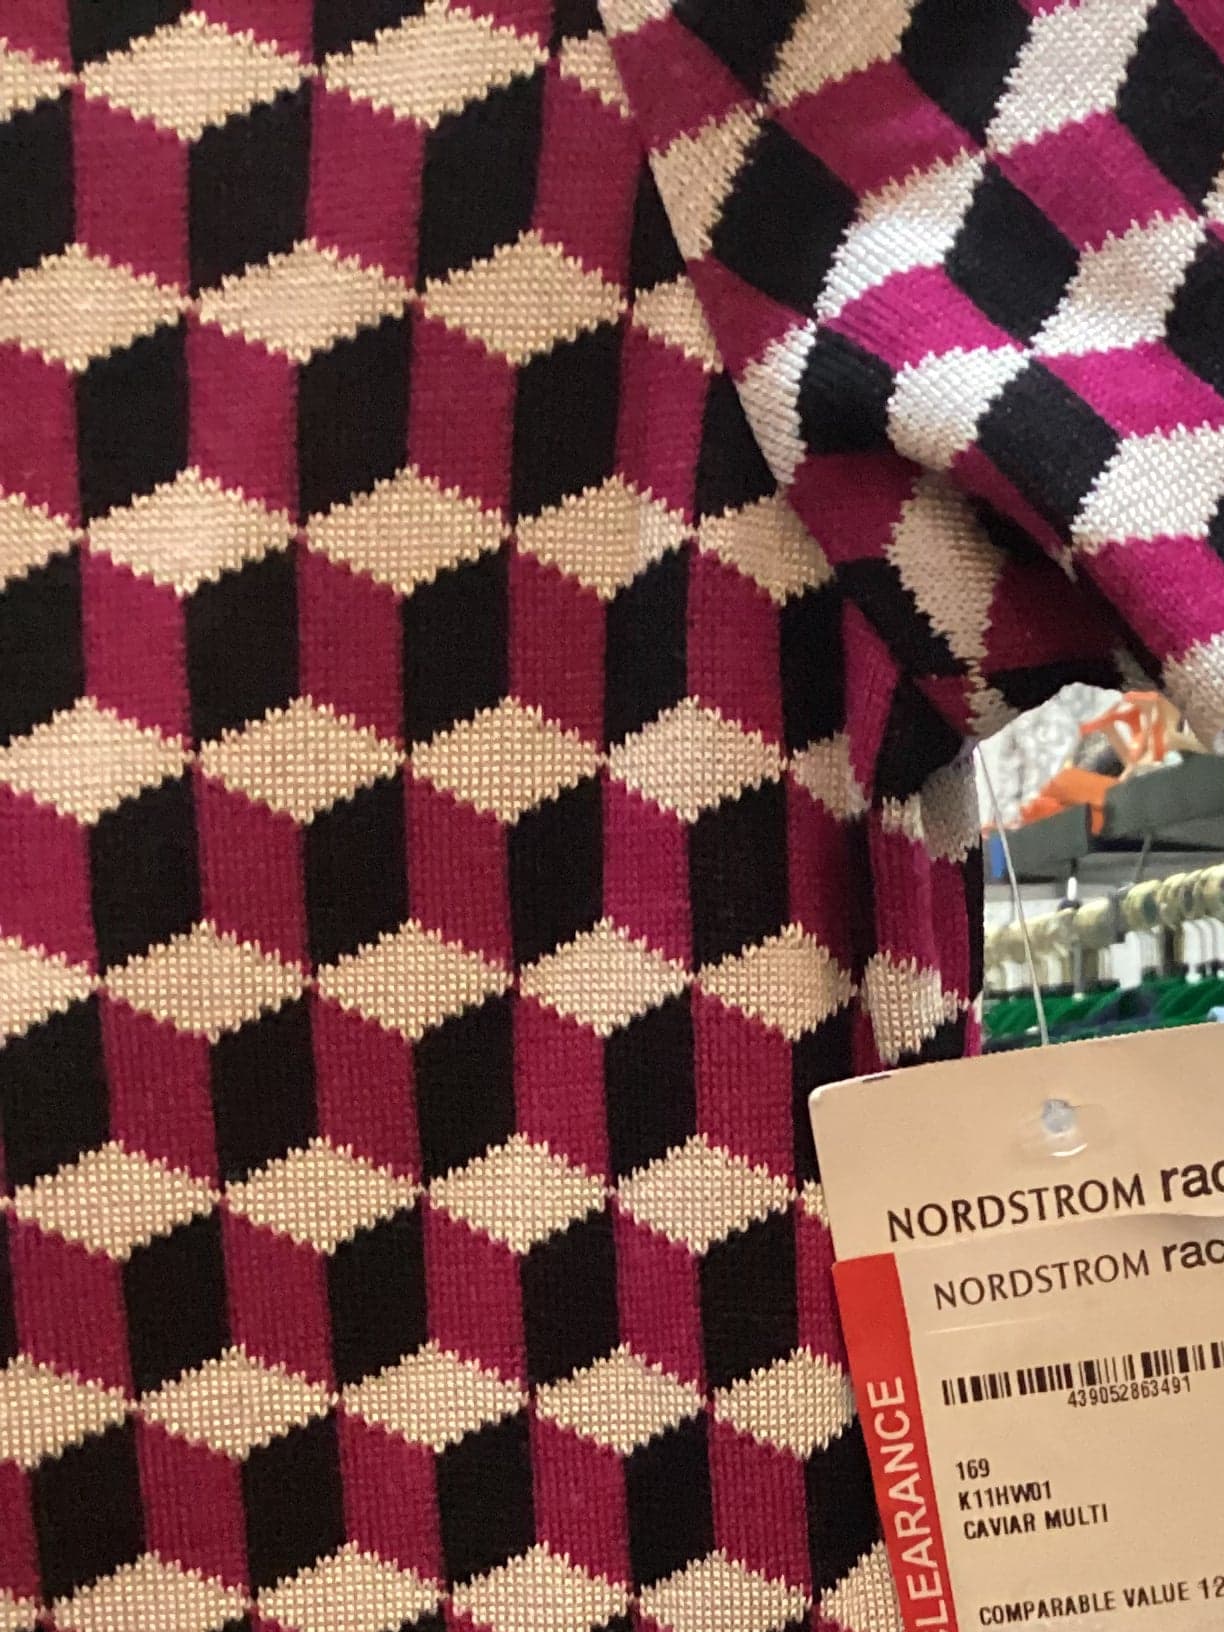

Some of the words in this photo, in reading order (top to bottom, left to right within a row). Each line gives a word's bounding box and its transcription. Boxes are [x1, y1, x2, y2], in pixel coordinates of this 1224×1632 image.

[887, 1173, 1146, 1243] NORDSTROM
[934, 1248, 1150, 1311] NORDSTROM
[1067, 1375, 1191, 1408] 439052863491
[956, 1458, 990, 1481] 169
[963, 1512, 1036, 1540] CAVIAR
[1044, 1503, 1109, 1530] MULTI
[979, 1590, 1117, 1626] COMPARABLE
[1123, 1581, 1190, 1609] VALUE
